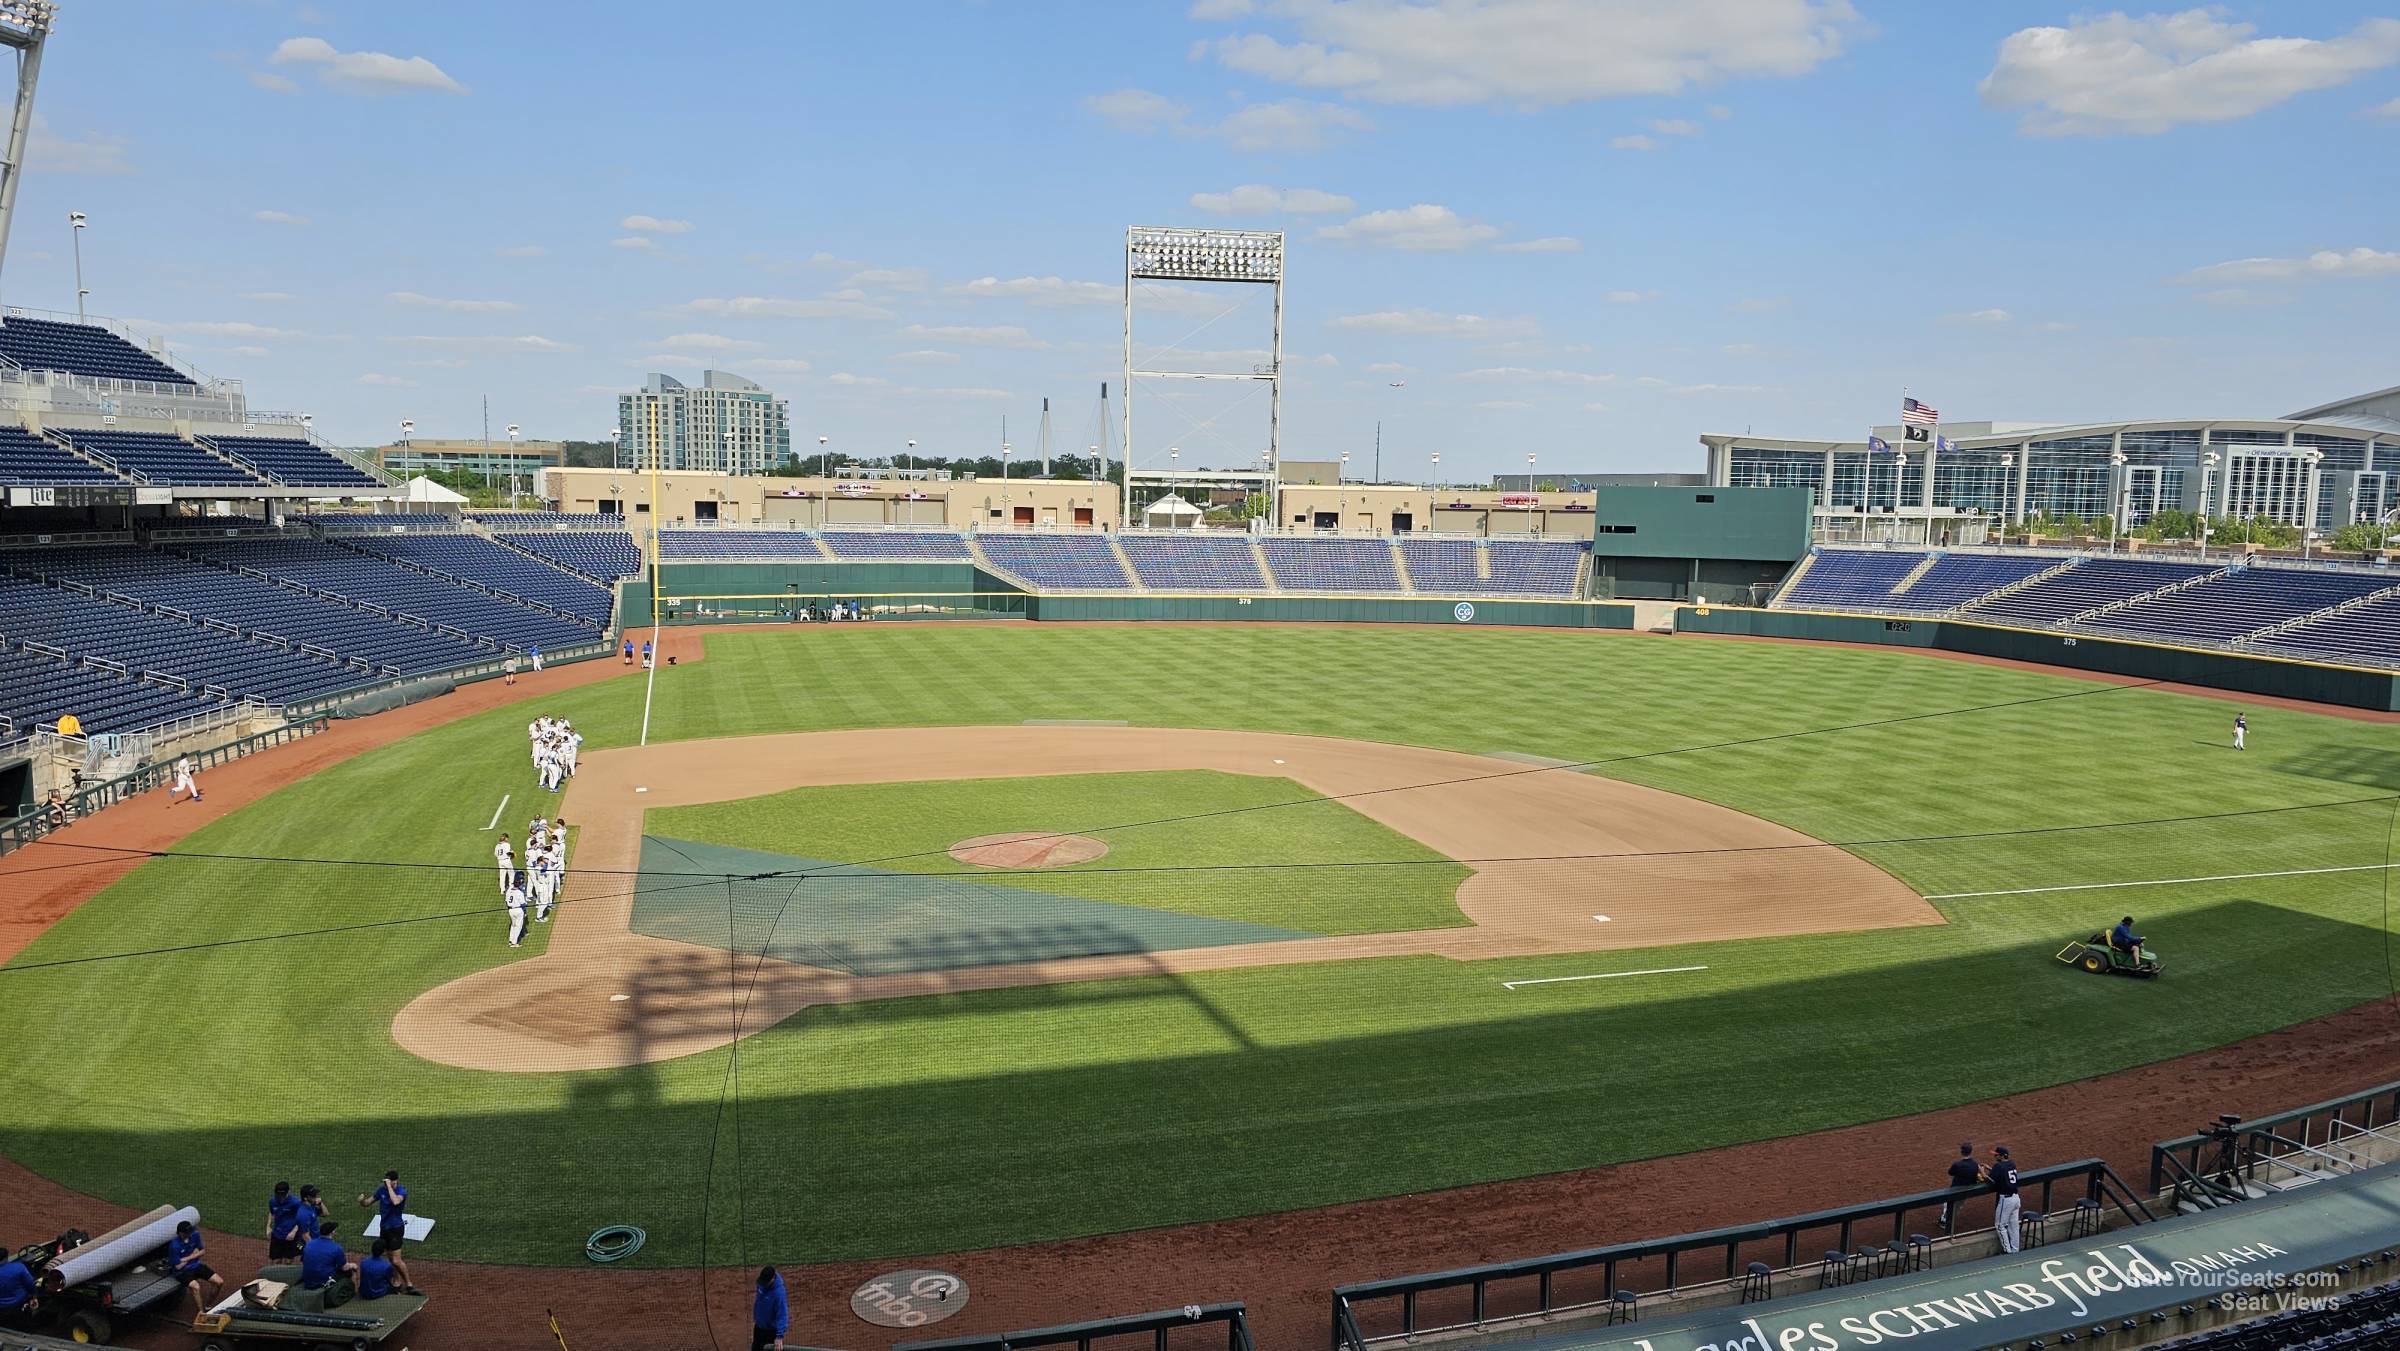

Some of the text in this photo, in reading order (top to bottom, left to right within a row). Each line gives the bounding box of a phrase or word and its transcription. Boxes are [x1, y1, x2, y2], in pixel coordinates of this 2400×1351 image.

[1695, 608, 1710, 616] 408
[2063, 637, 2077, 646] 375
[497, 848, 504, 856] 13
[1839, 1282, 2056, 1344] SCHWAB
[2041, 1244, 2173, 1317] field
[2170, 1242, 2289, 1276] OMAHA
[857, 1282, 928, 1327] fnbo
